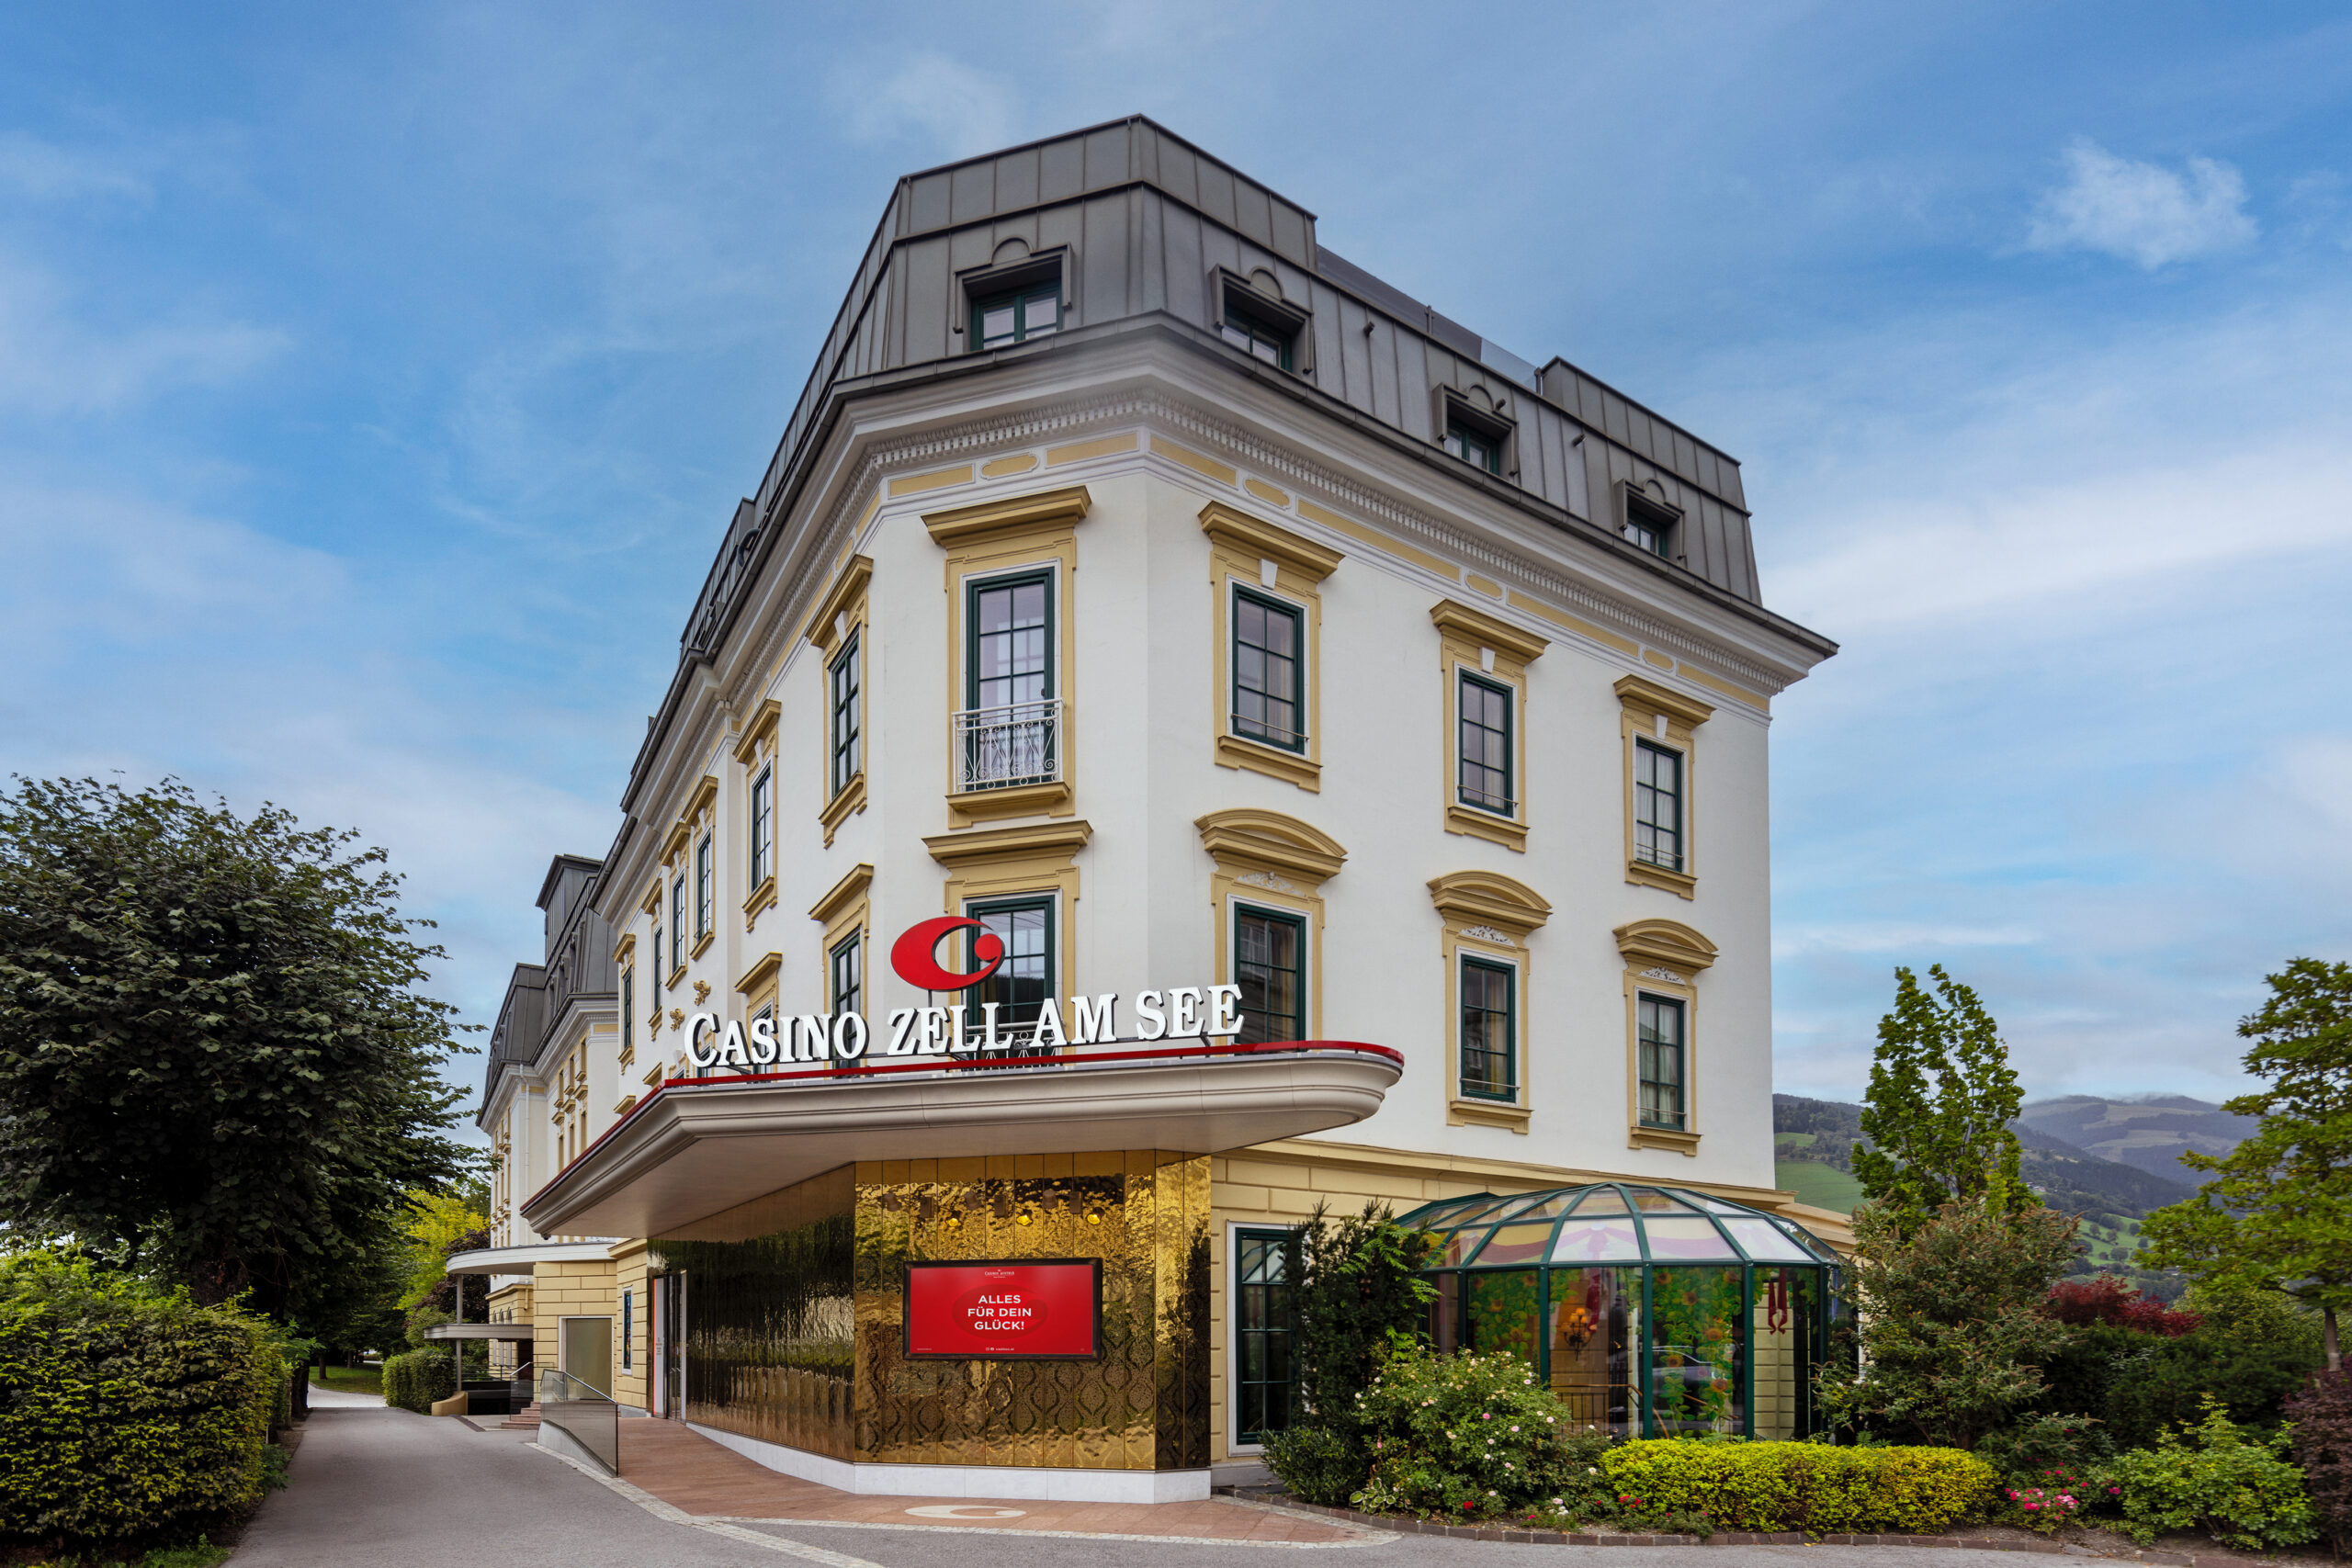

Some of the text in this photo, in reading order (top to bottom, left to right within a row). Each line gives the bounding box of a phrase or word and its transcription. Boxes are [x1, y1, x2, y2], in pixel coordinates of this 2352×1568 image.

[684, 984, 1244, 1067] CASINO ZELL AM SEE
[978, 1295, 1021, 1303] ALLES
[967, 1306, 1032, 1317] FÜR DEIN
[974, 1319, 1024, 1330] GLÜCK!
